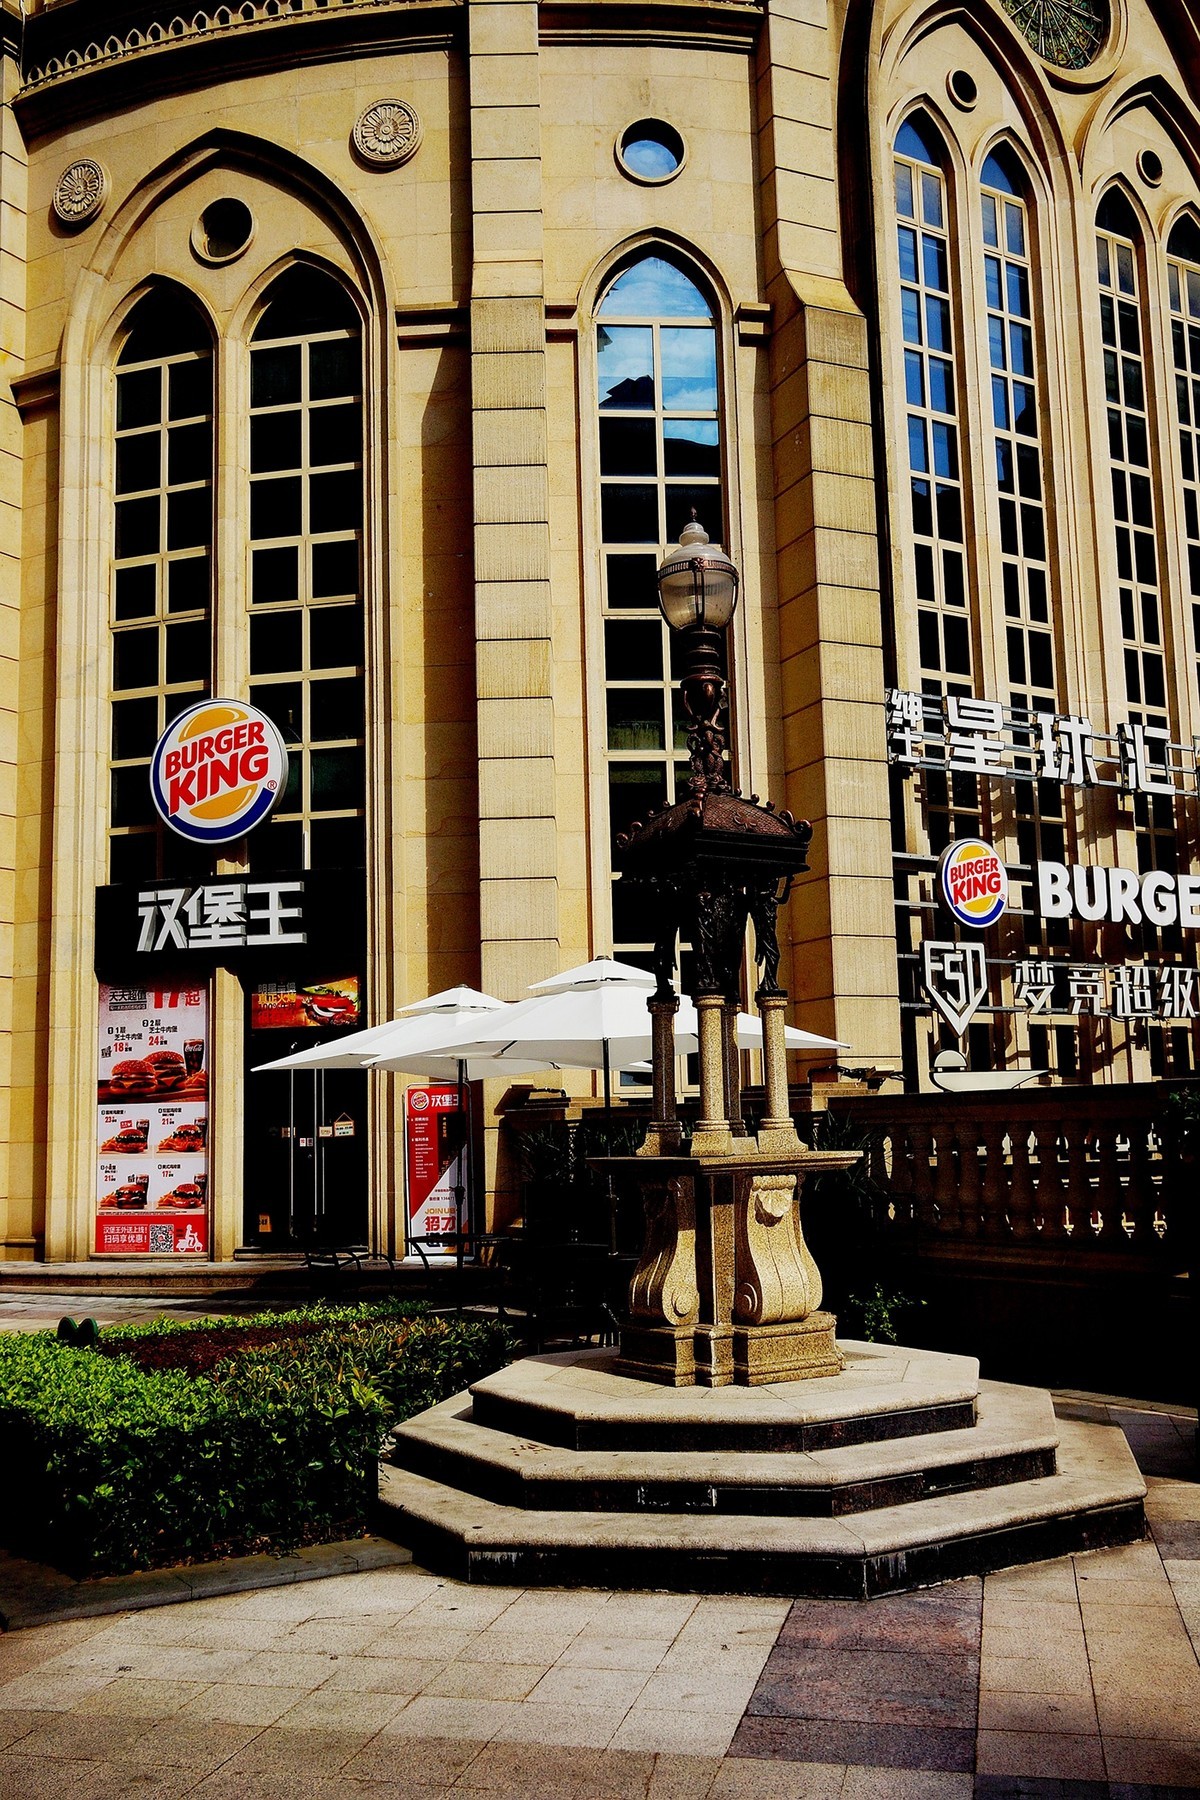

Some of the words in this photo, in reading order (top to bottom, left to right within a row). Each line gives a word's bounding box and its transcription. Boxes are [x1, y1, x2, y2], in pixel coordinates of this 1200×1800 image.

[165, 721, 265, 780] BURGER
[168, 745, 269, 816] KING
[950, 857, 999, 884] BURGER
[953, 872, 1001, 906] KING
[137, 881, 308, 952] 汉堡王
